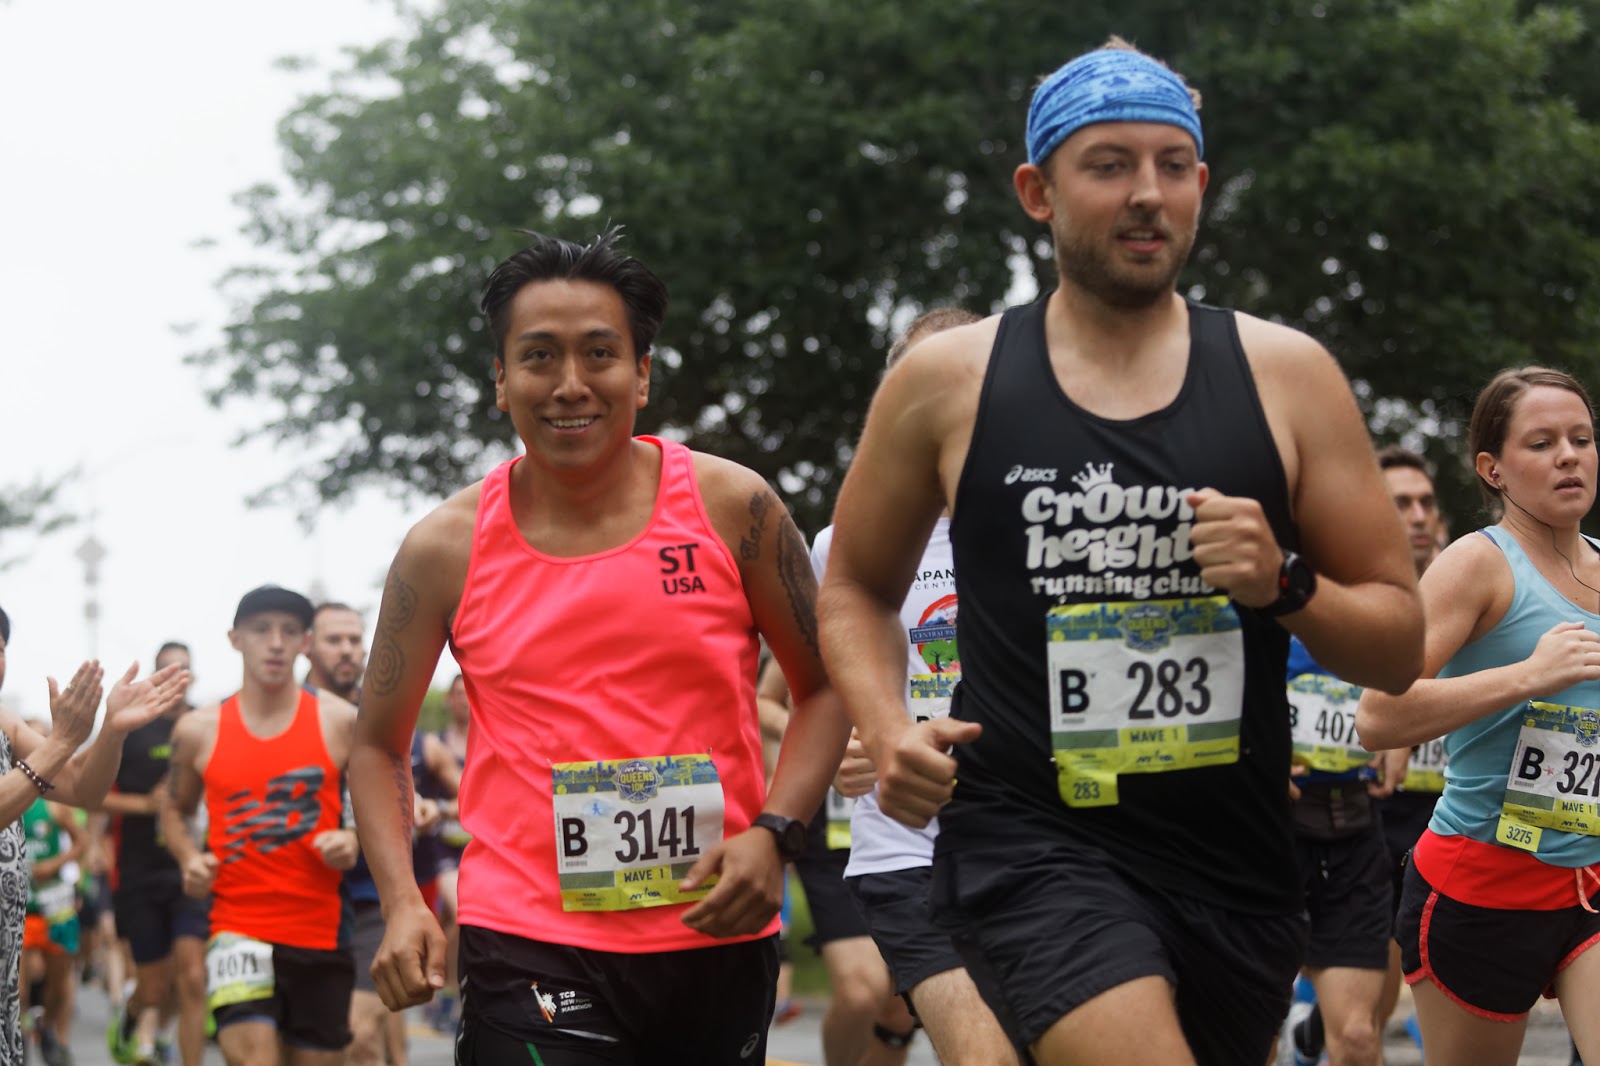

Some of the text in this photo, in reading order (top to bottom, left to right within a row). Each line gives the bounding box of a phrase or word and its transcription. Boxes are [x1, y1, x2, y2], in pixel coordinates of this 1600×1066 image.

[659, 543, 699, 574] ST
[663, 576, 706, 595] USA
[1030, 571, 1152, 599] running
[914, 628, 957, 639] CENTRAL PA
[1060, 656, 1211, 720] B 283
[1130, 728, 1179, 743] WAVE 1
[1315, 710, 1361, 744] 407
[1518, 746, 1545, 780] B
[620, 771, 655, 784] QUEENS
[1073, 781, 1100, 800] 283
[1562, 801, 1584, 813] WAVE
[562, 817, 588, 857] B
[613, 805, 700, 863] 3141
[1506, 825, 1533, 844] 3275
[624, 868, 664, 882] WAVE 1
